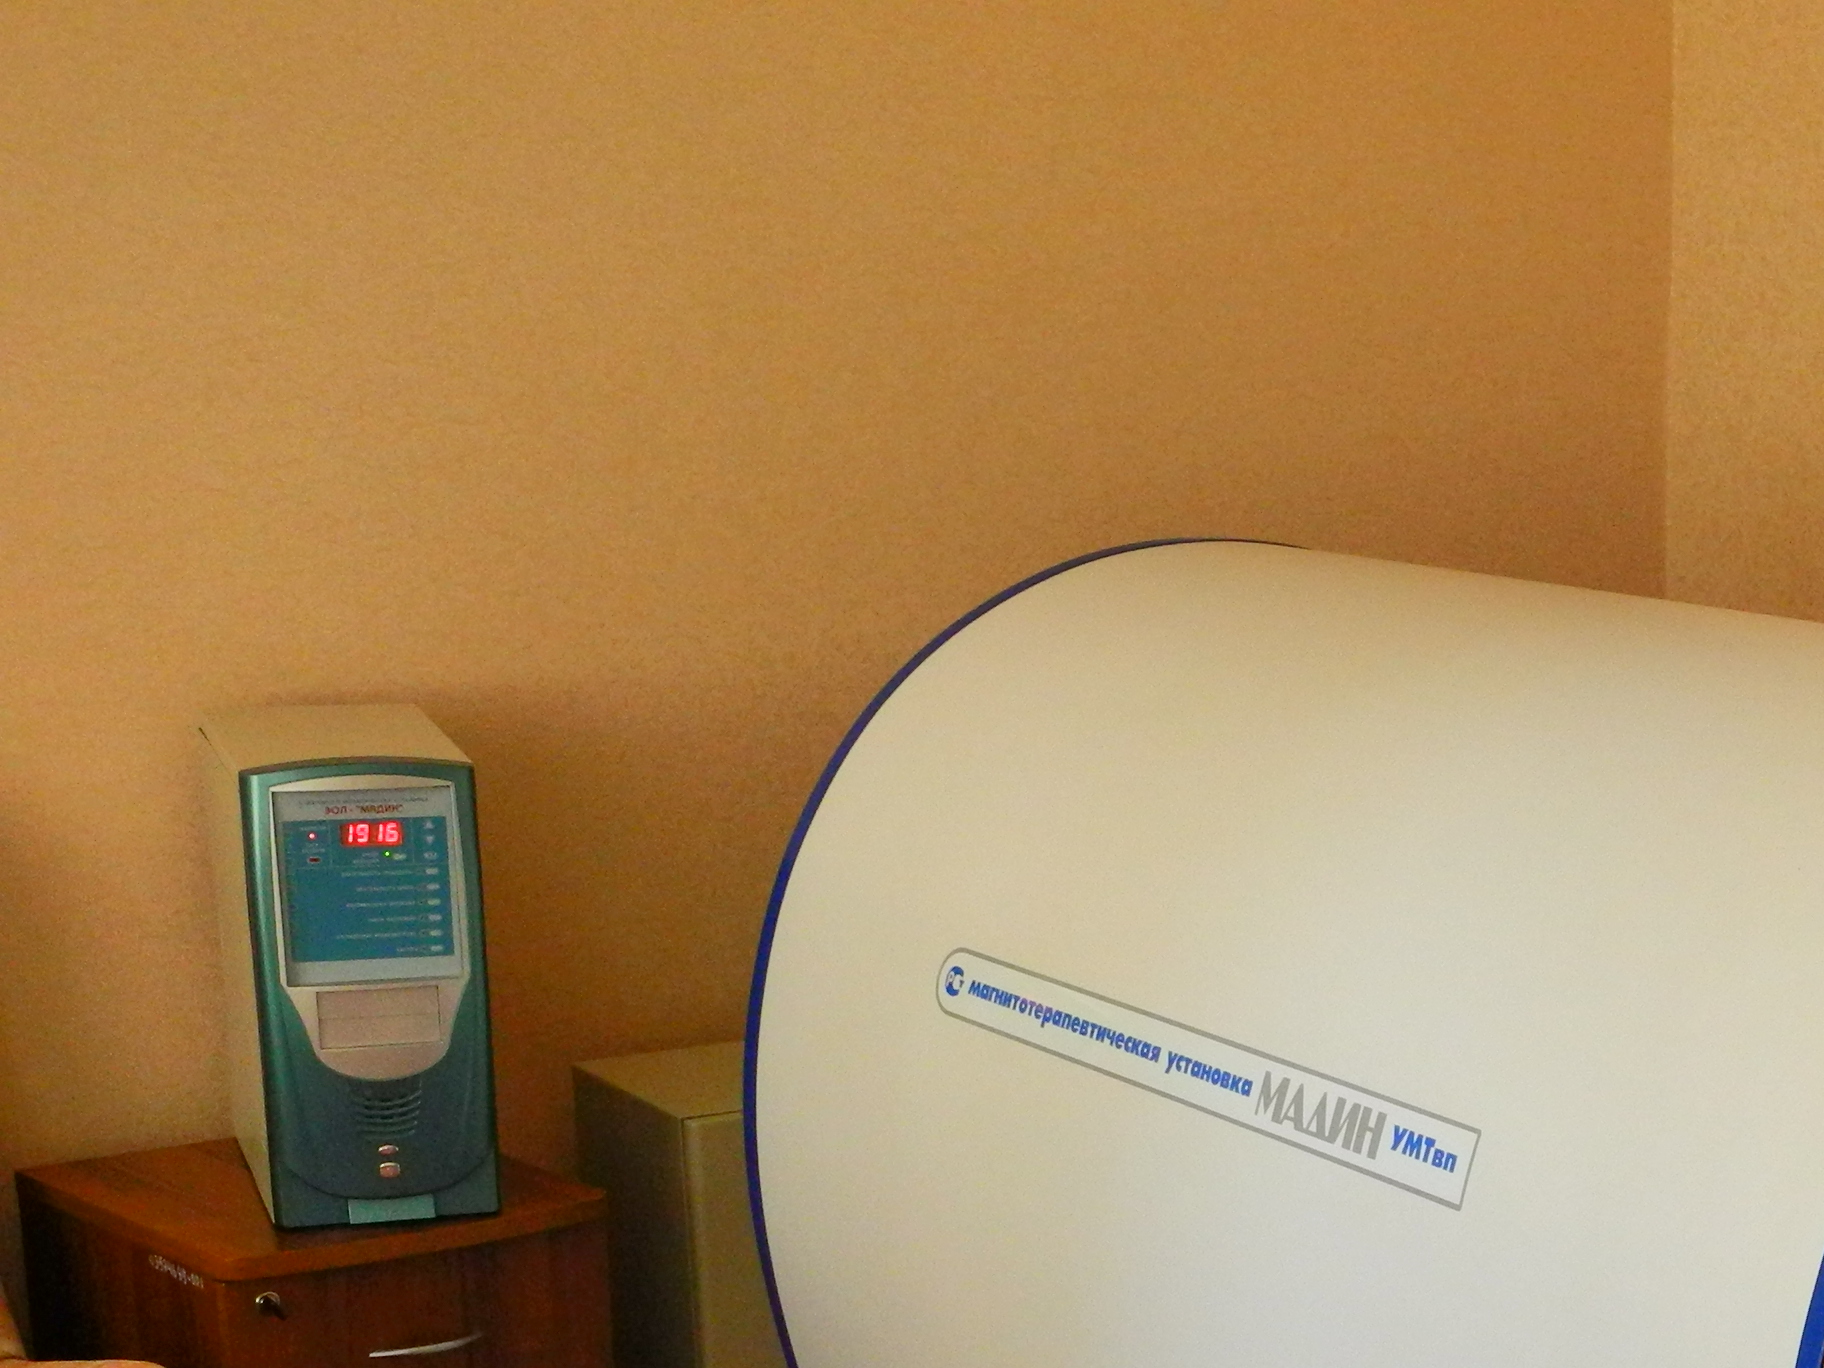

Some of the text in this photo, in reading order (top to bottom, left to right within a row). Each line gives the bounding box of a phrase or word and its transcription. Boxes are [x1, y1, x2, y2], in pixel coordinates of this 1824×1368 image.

[968, 979, 1458, 1173] магнитотерапевтическая установка МАДИН УМТвп
